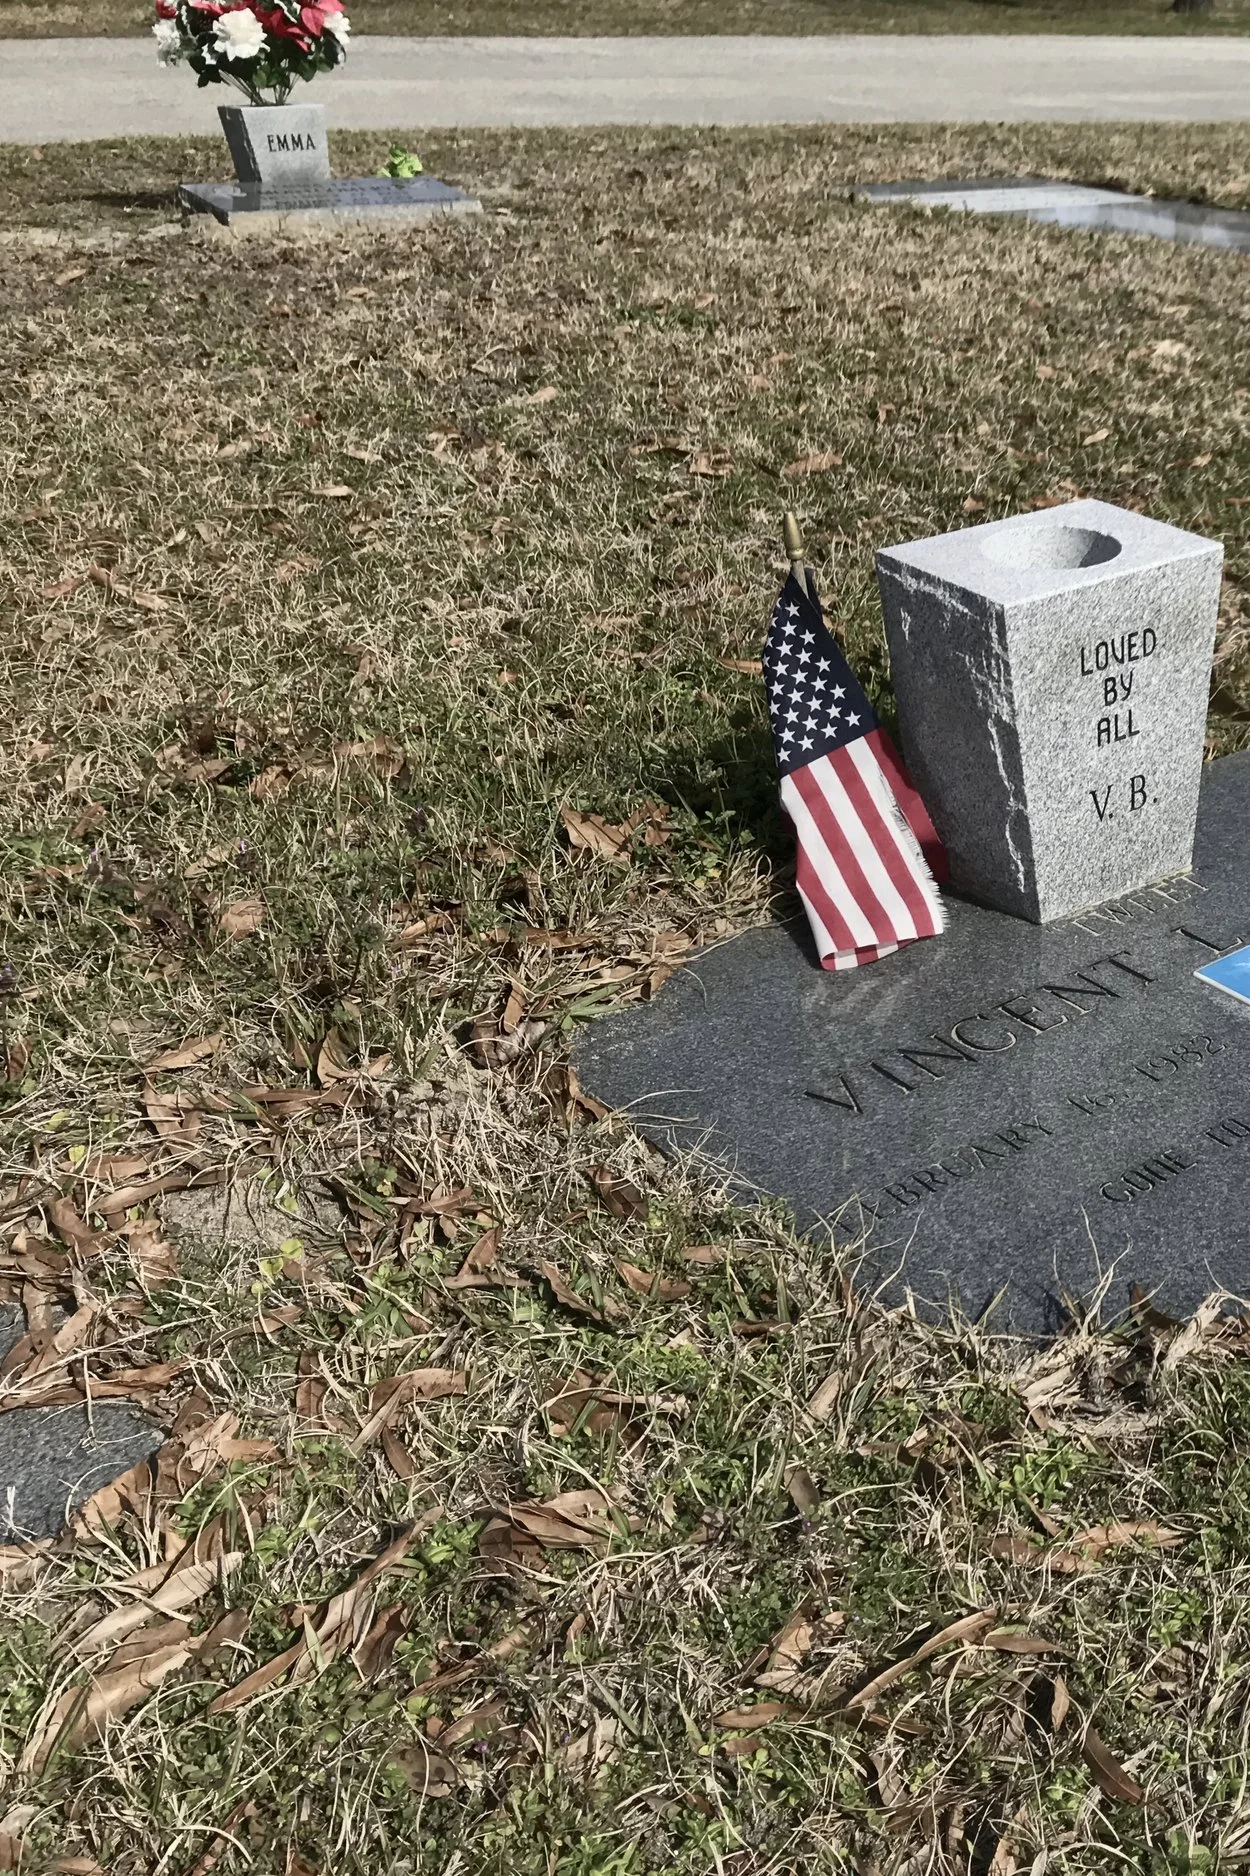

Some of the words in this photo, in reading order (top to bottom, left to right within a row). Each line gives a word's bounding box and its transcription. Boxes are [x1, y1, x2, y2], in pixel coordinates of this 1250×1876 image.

[266, 133, 316, 152] EMMA
[1081, 628, 1157, 676] LOVED
[1104, 669, 1135, 706] BY
[1097, 709, 1140, 747] ALL
[1089, 785, 1115, 822] V.
[1129, 774, 1158, 812] B.
[800, 950, 1159, 1115] VINCENT
[1131, 1034, 1229, 1083] 1982
[1099, 1149, 1200, 1204] GONE
